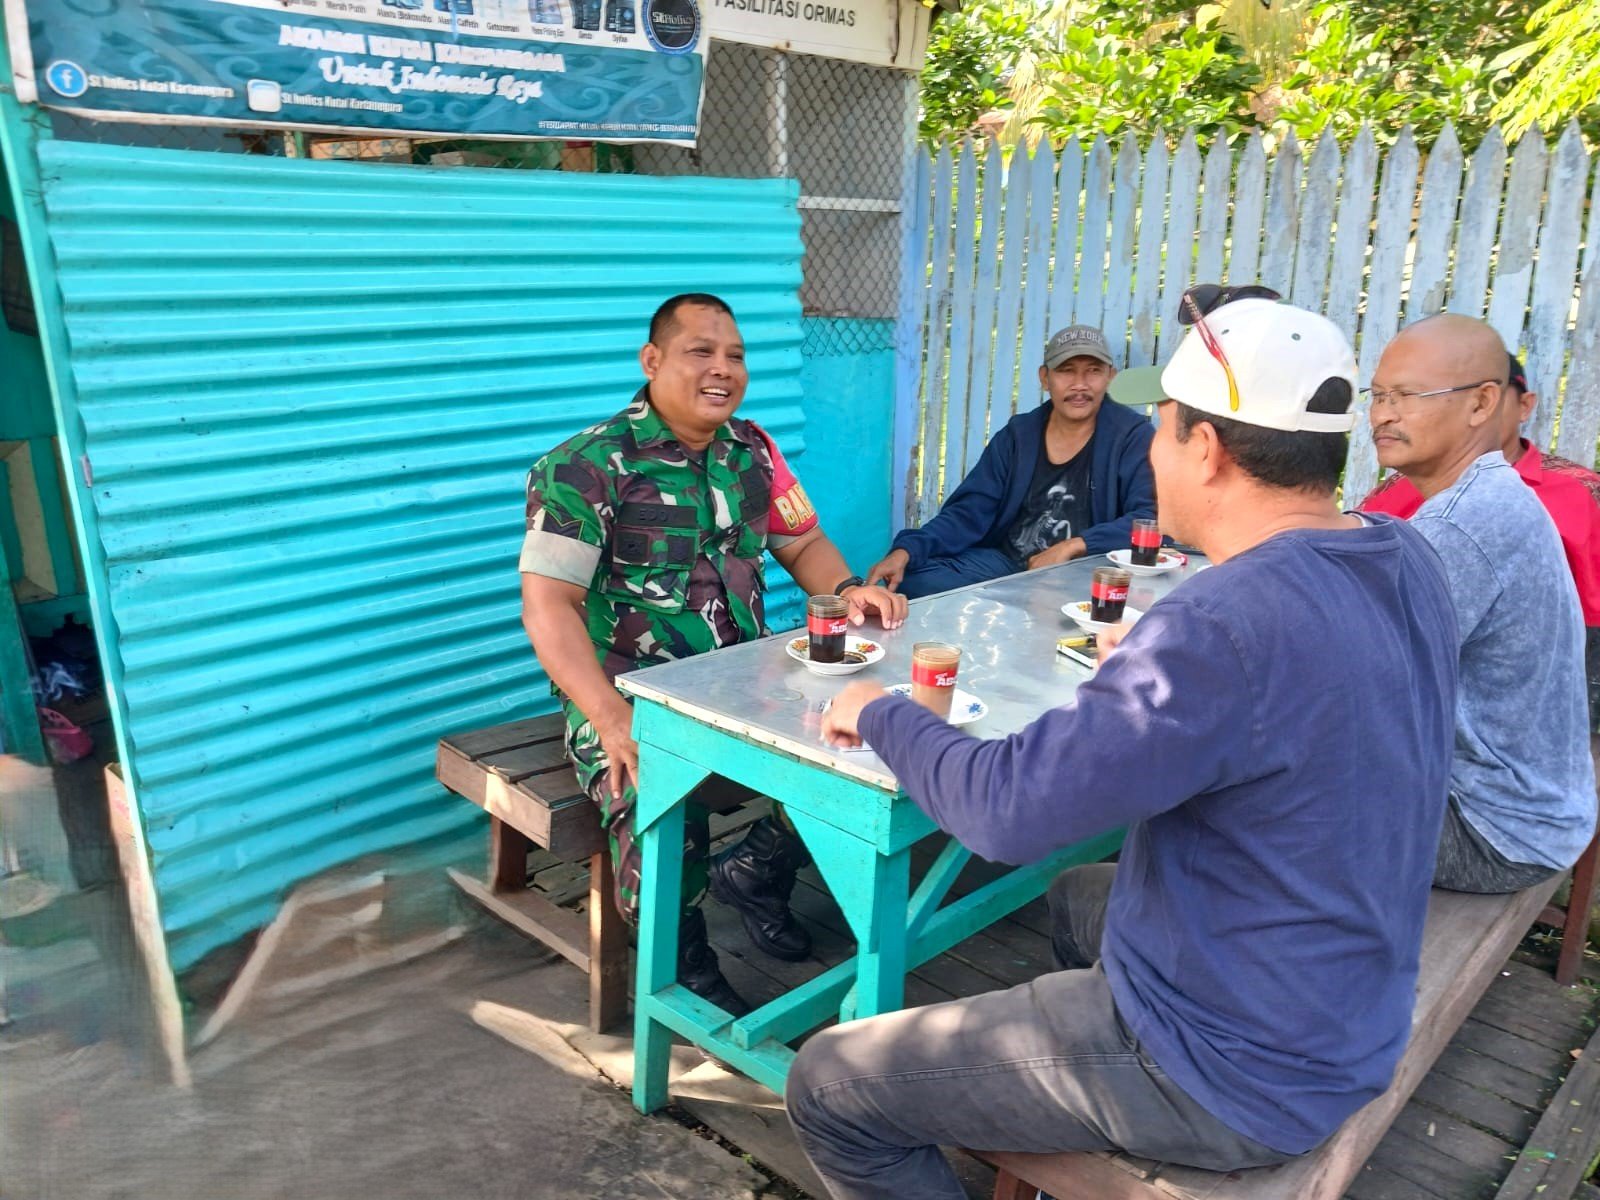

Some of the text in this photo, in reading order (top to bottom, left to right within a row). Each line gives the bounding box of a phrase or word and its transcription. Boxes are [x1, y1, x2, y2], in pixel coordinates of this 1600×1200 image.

[803, 3, 855, 27] ORMAS
[1056, 329, 1104, 346] NEW YORK
